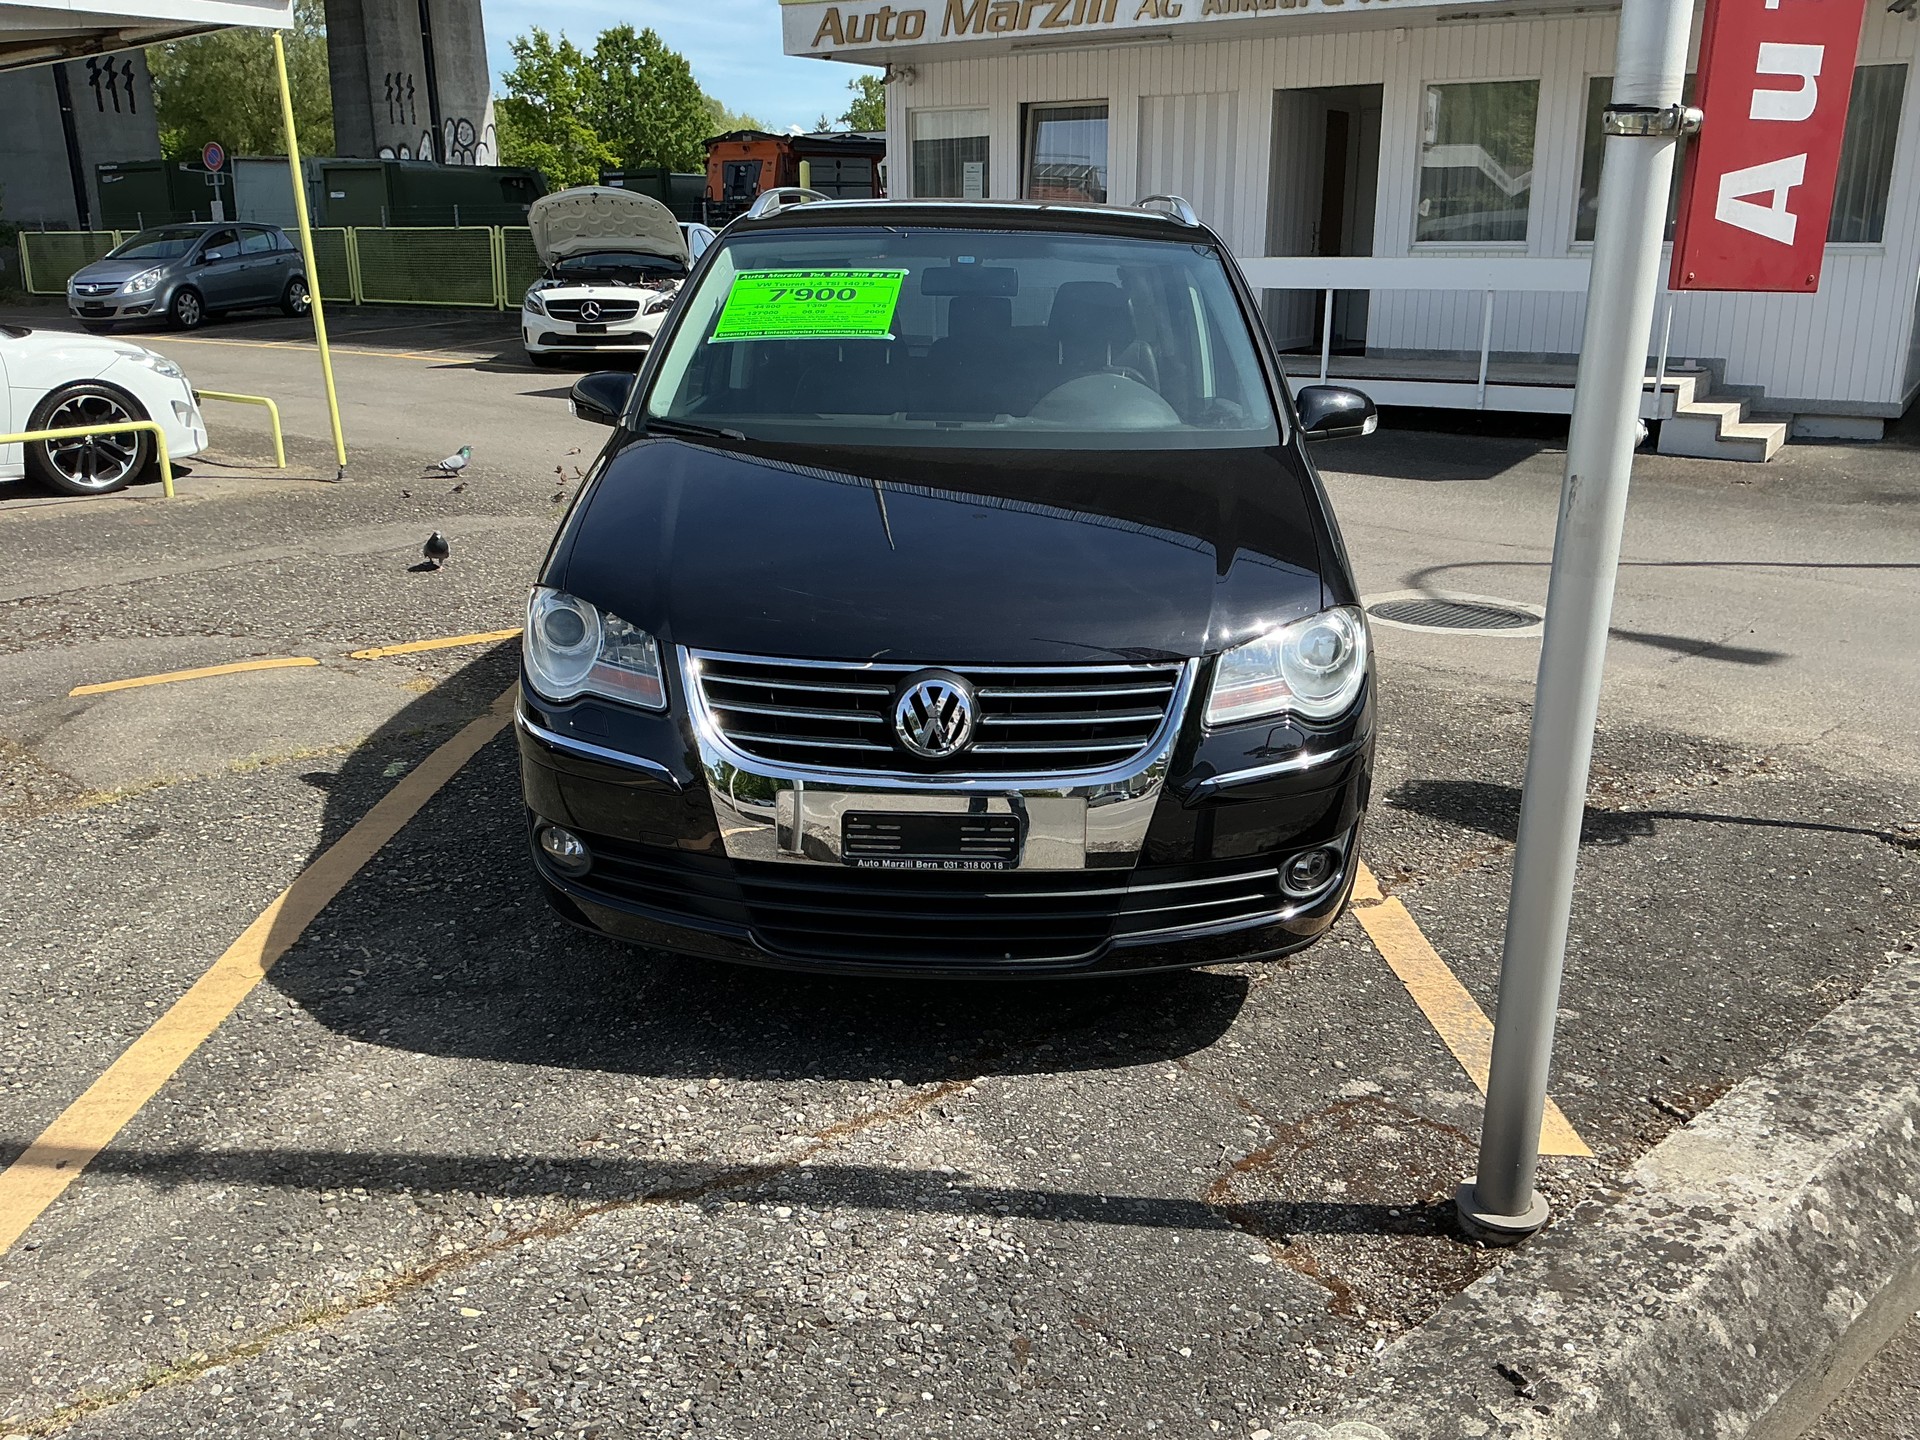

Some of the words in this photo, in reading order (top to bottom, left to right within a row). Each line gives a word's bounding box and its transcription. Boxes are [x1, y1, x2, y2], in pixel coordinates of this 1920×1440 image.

[811, 7, 926, 48] Auto
[1133, 0, 1183, 22] AG
[1715, 0, 1826, 246] Au
[769, 288, 857, 303] 7'900
[857, 859, 880, 869] Auto
[882, 859, 913, 869] Marzili
[916, 860, 938, 869] Bern
[943, 861, 960, 870] 031
[963, 861, 979, 870] 318
[980, 862, 991, 870] 00
[992, 862, 1004, 870] 18
